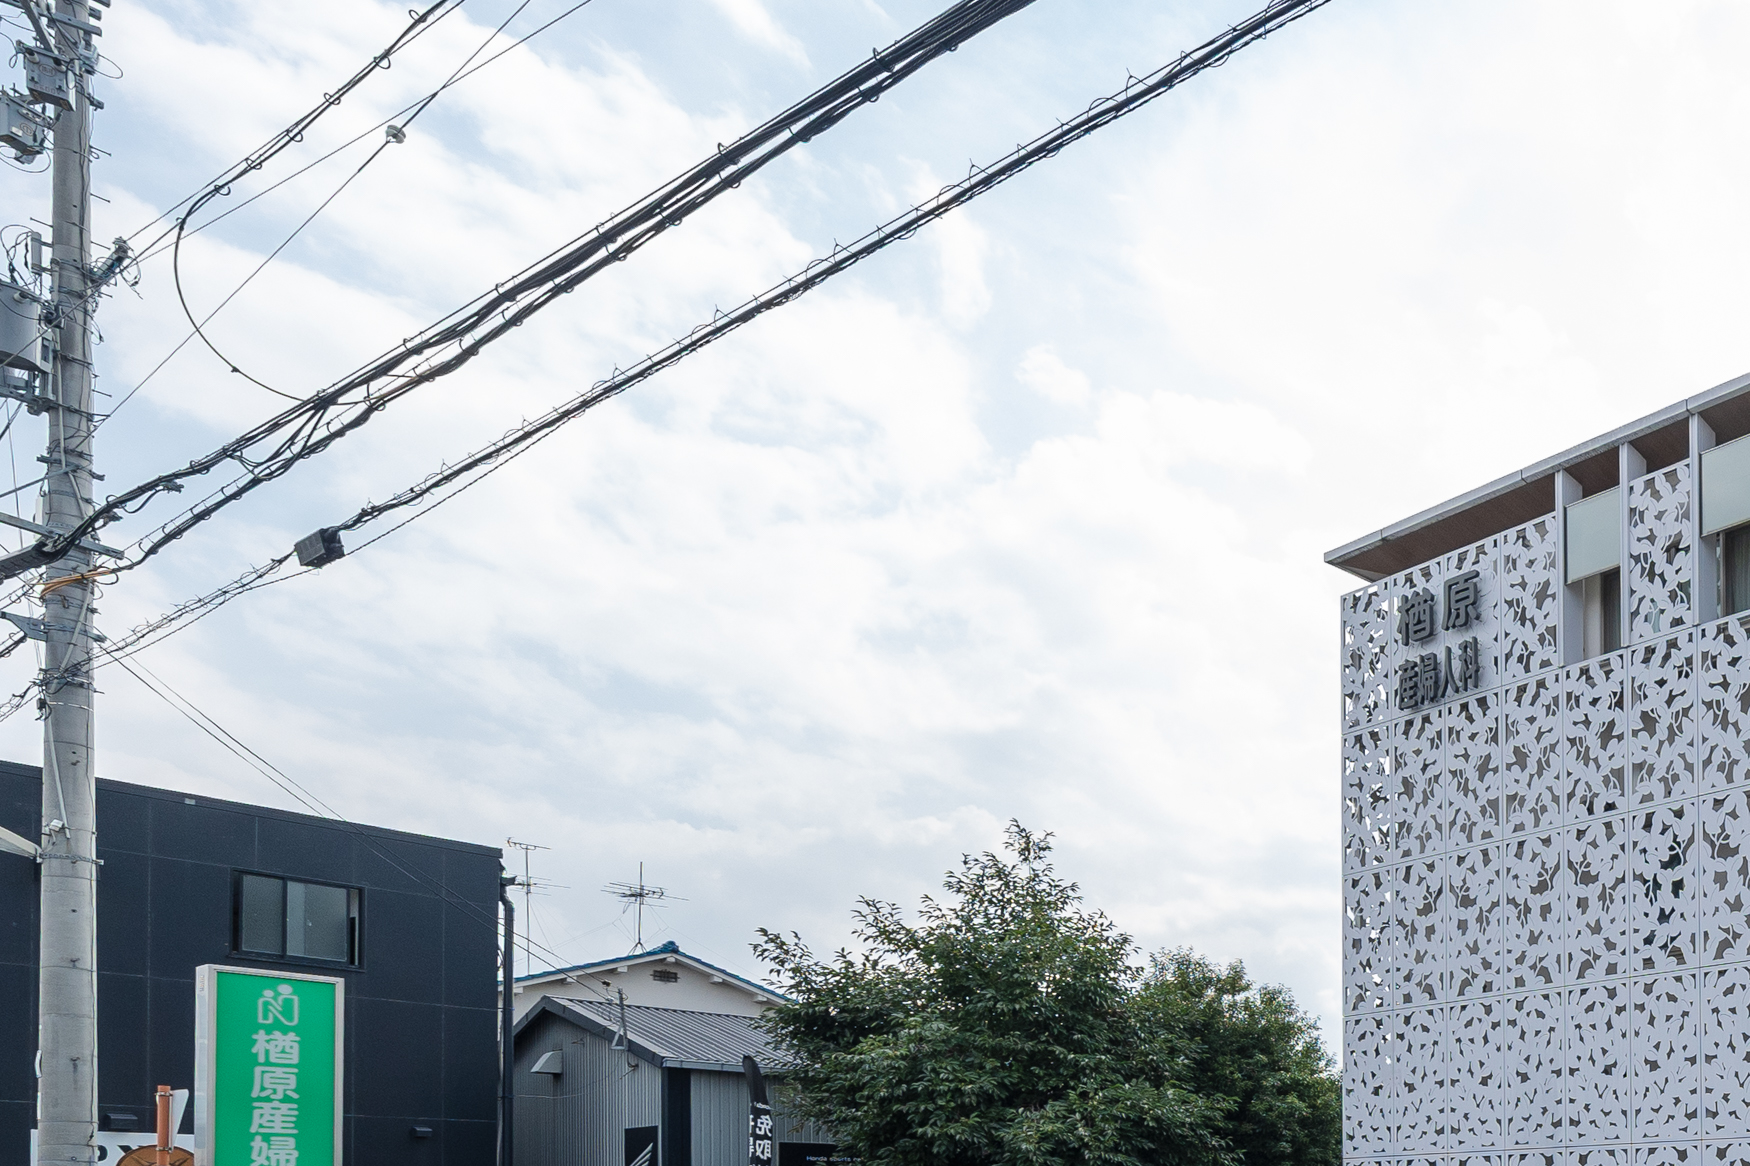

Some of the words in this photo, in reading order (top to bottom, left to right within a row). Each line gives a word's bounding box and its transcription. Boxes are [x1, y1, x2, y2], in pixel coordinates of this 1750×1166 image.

[1396, 569, 1481, 647] 楢原
[1397, 636, 1481, 711] 産婦人科
